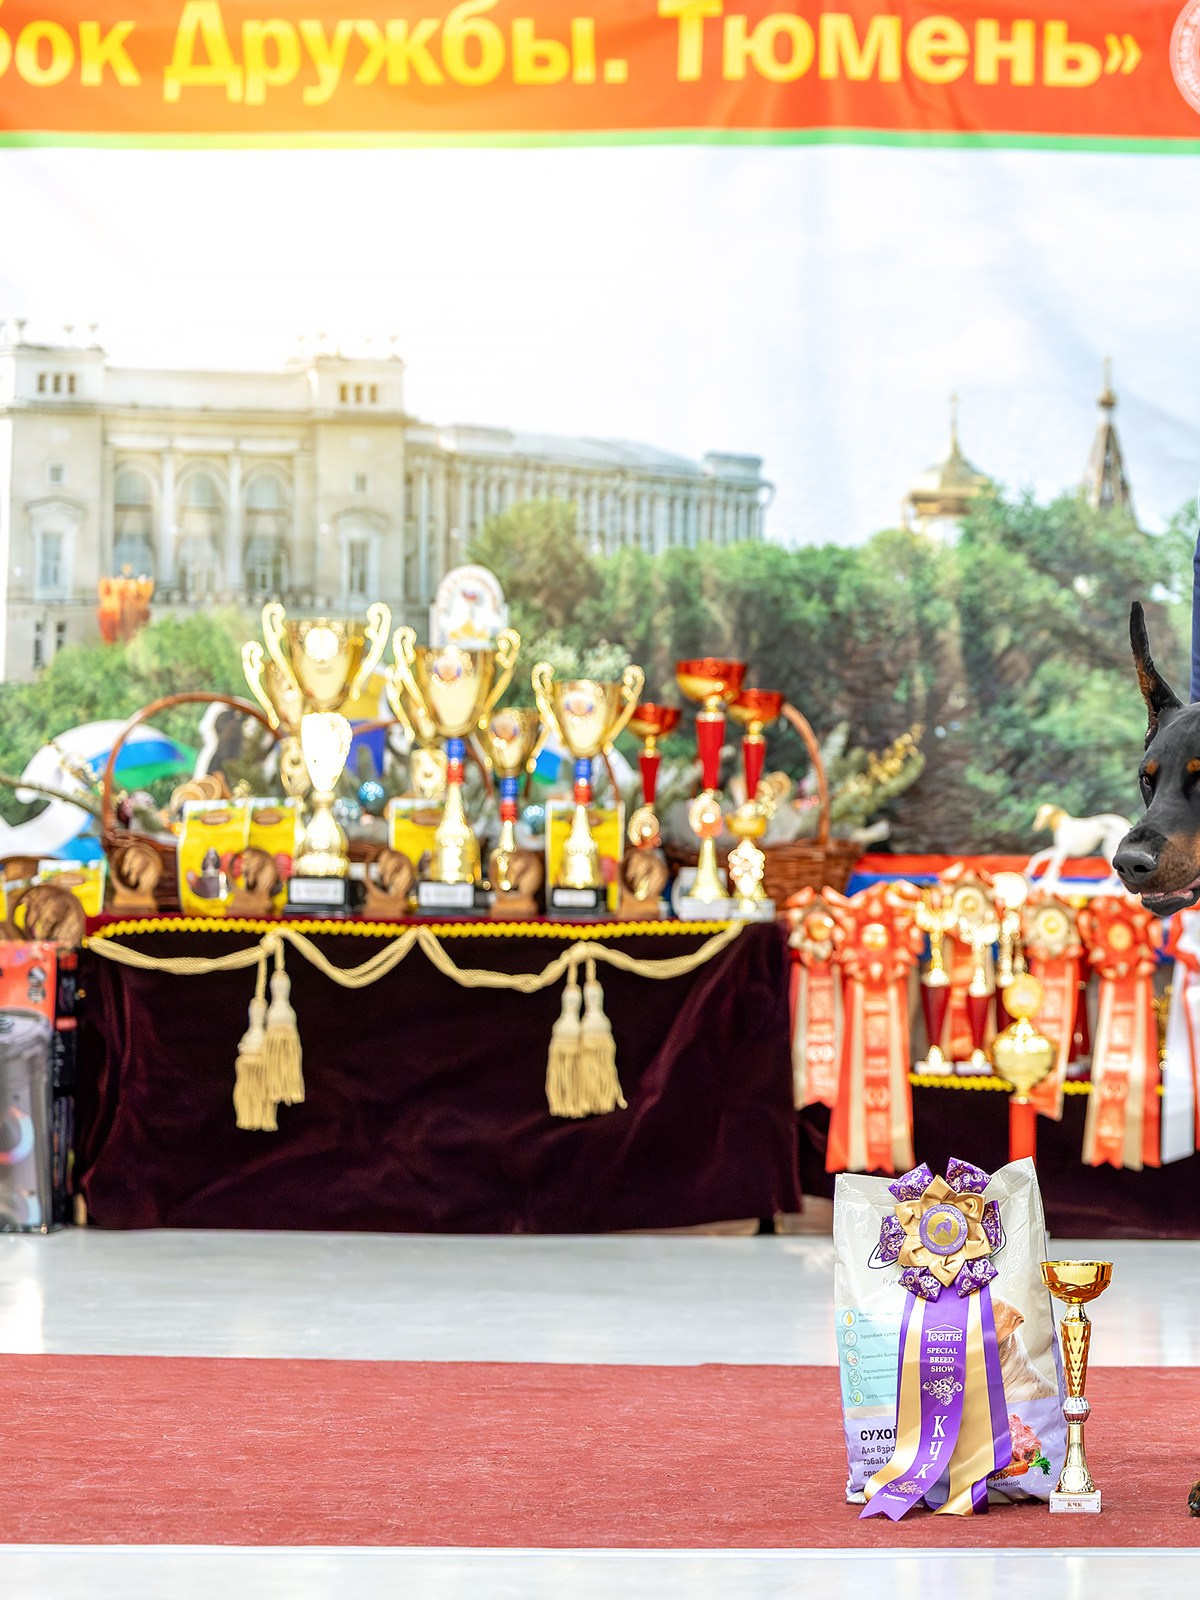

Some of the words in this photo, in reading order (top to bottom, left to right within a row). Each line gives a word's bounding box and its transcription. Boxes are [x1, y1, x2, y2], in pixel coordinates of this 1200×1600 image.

[0, 21, 140, 88] ок
[163, 0, 628, 105] Дружбы.
[658, 0, 1142, 88] Тюмень»
[930, 1365, 955, 1373] SHOW
[861, 1446, 876, 1455] Для
